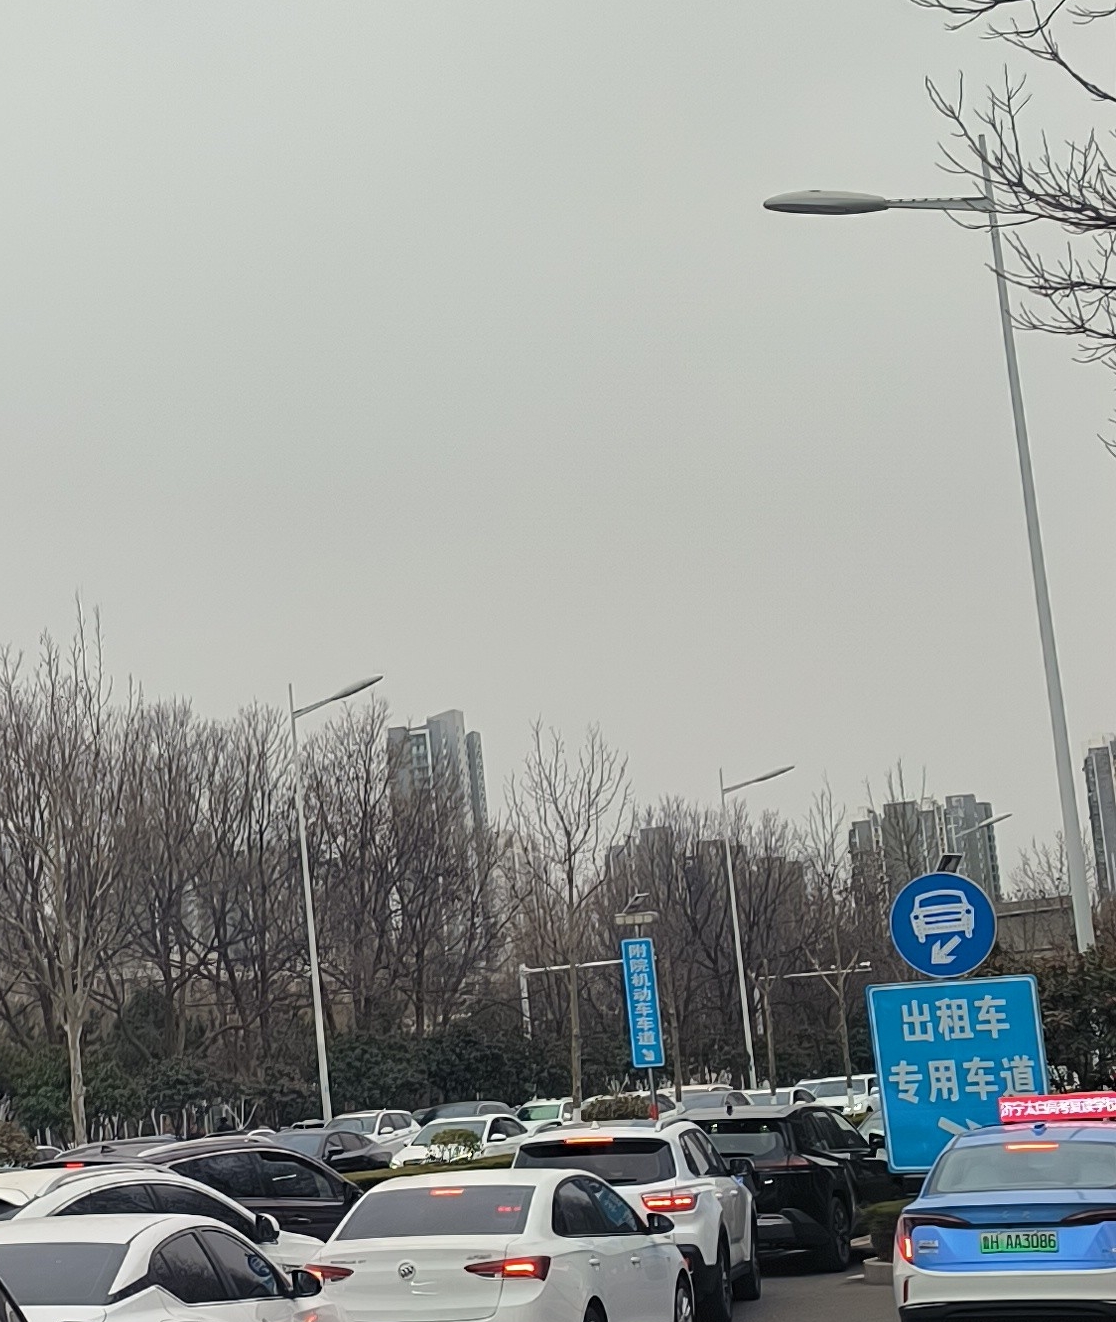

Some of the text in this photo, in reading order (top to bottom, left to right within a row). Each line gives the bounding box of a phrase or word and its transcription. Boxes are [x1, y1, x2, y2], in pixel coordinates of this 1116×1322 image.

[628, 943, 657, 1045] 附院机动车车道
[900, 995, 1010, 1043] 出租车
[888, 1055, 1035, 1105] 专用车道
